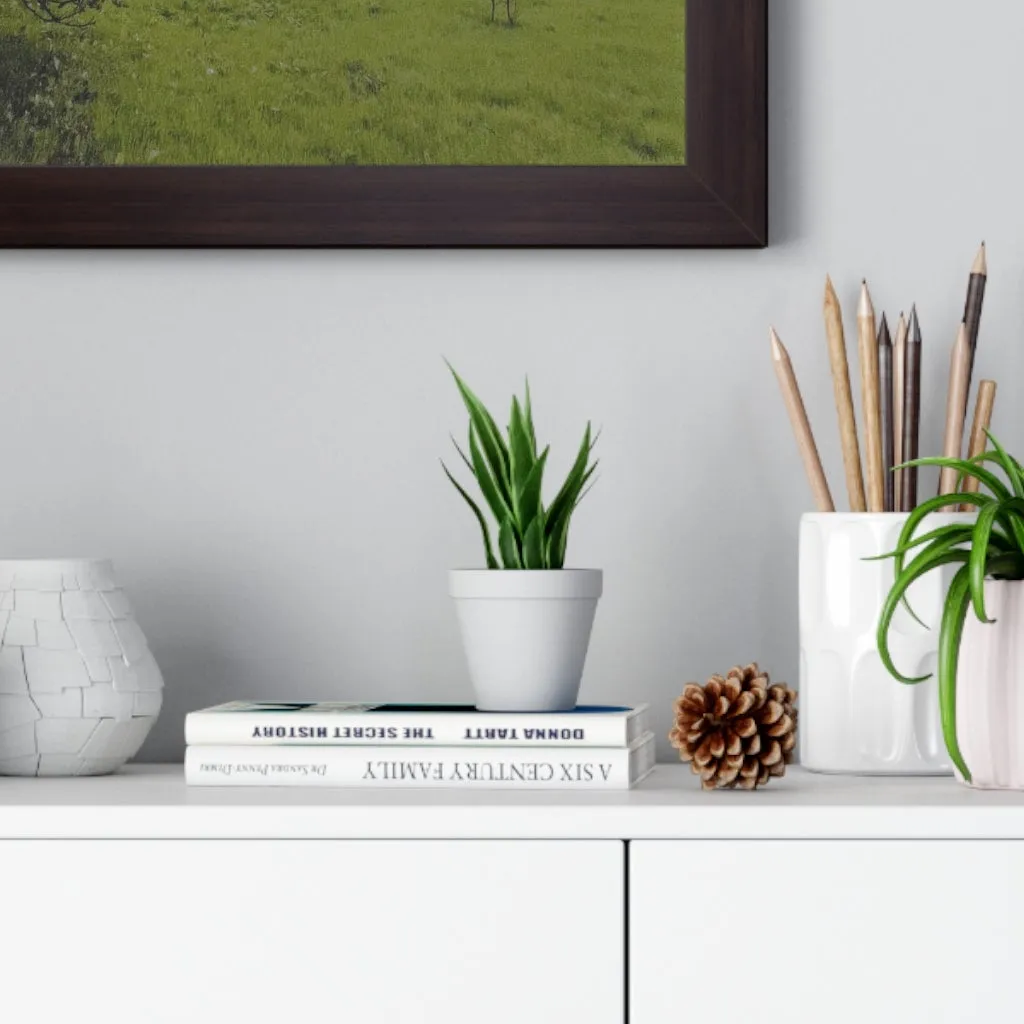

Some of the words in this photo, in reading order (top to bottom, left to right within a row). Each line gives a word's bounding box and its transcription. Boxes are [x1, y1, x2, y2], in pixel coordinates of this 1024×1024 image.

[251, 726, 327, 739] HISTORY
[332, 726, 398, 740] SECRET
[403, 726, 435, 740] THE
[463, 727, 519, 741] TARTT
[523, 727, 585, 741] DONNA
[362, 760, 444, 780] FAMILY
[449, 761, 554, 782] CENTURY
[559, 762, 594, 782] SIX
[598, 762, 613, 781] A
